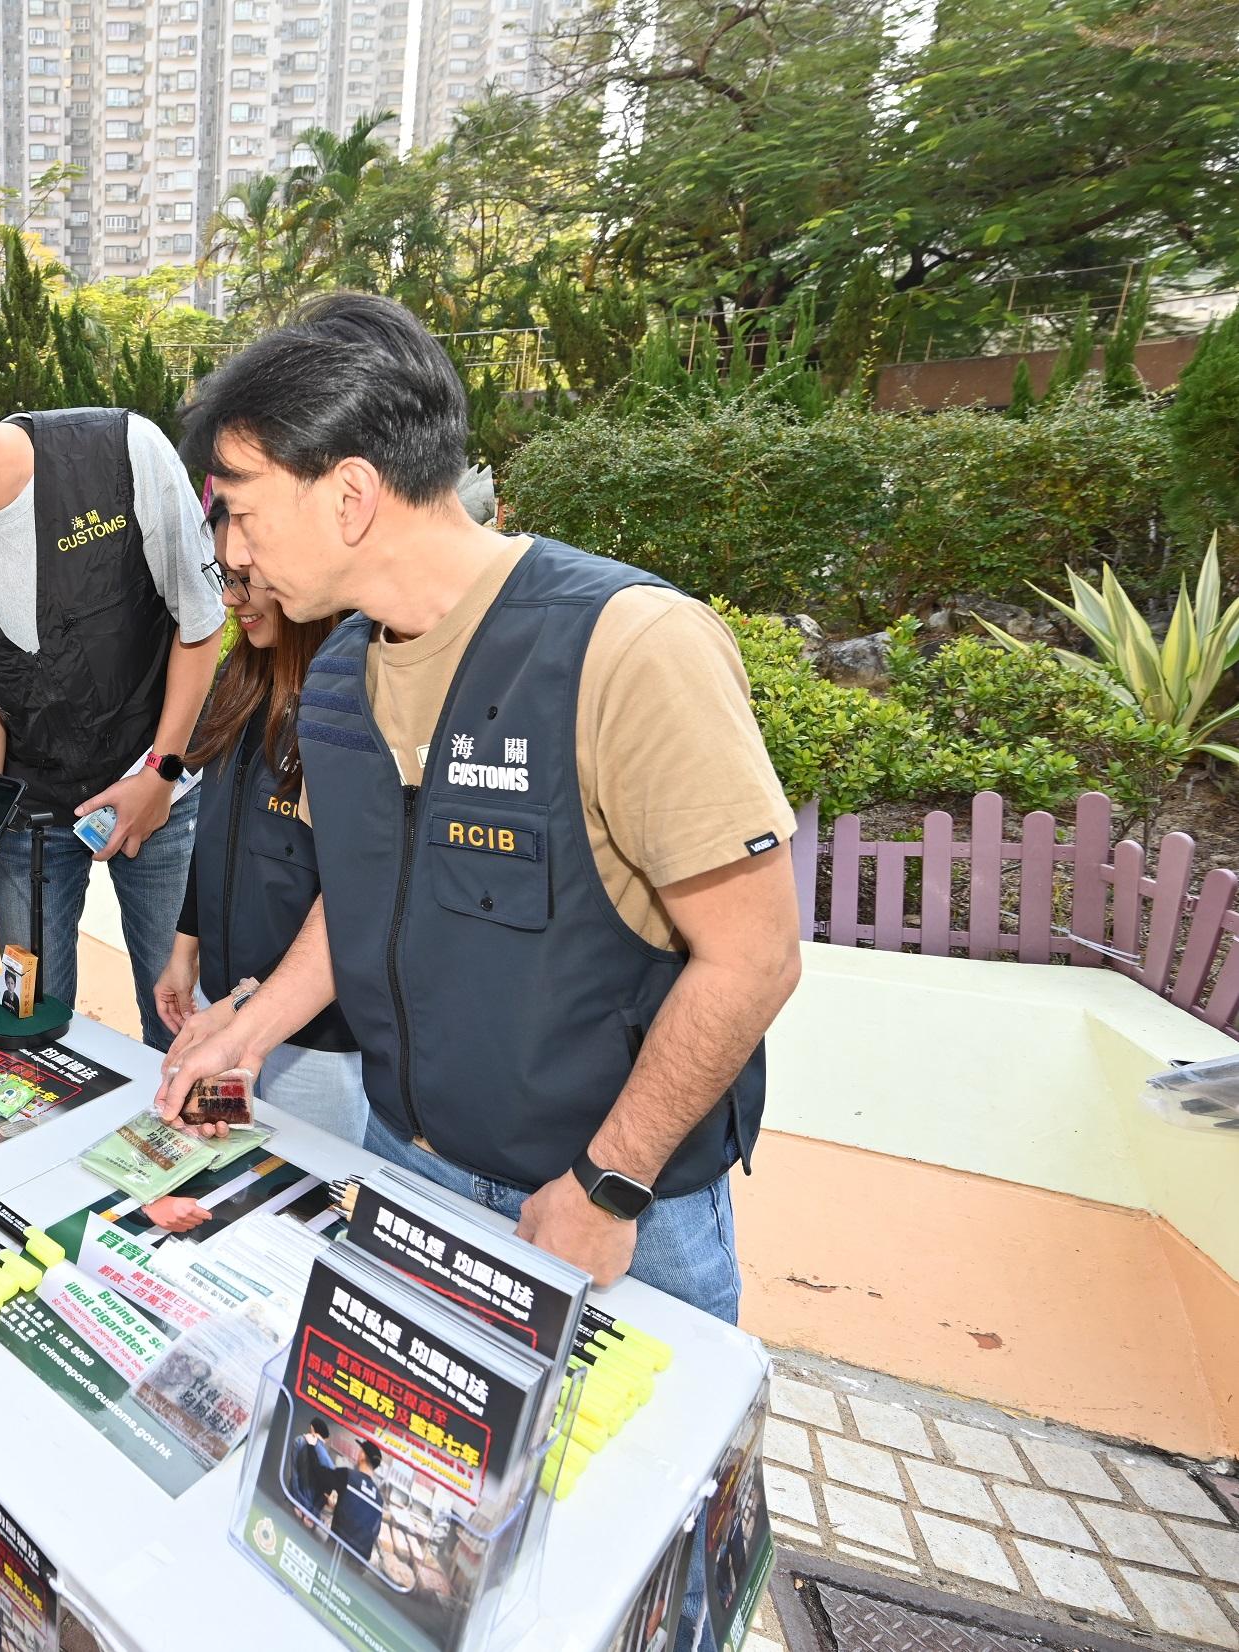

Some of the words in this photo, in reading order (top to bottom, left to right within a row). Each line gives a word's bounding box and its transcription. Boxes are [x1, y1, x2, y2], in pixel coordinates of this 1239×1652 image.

[58, 515, 127, 551] CUSTOMS
[451, 734, 528, 764] 海關
[448, 761, 529, 792] CUSTOMS
[267, 796, 298, 818] RCI
[449, 822, 515, 851] RCIB
[64, 1281, 95, 1307] illicit
[91, 1306, 147, 1356] cigarettes
[97, 1290, 137, 1326] Buying
[135, 1324, 151, 1336] or
[55, 1332, 73, 1349] 182
[70, 1345, 95, 1367] 8080
[38, 1342, 173, 1460] crimereport@customs.gov.hk
